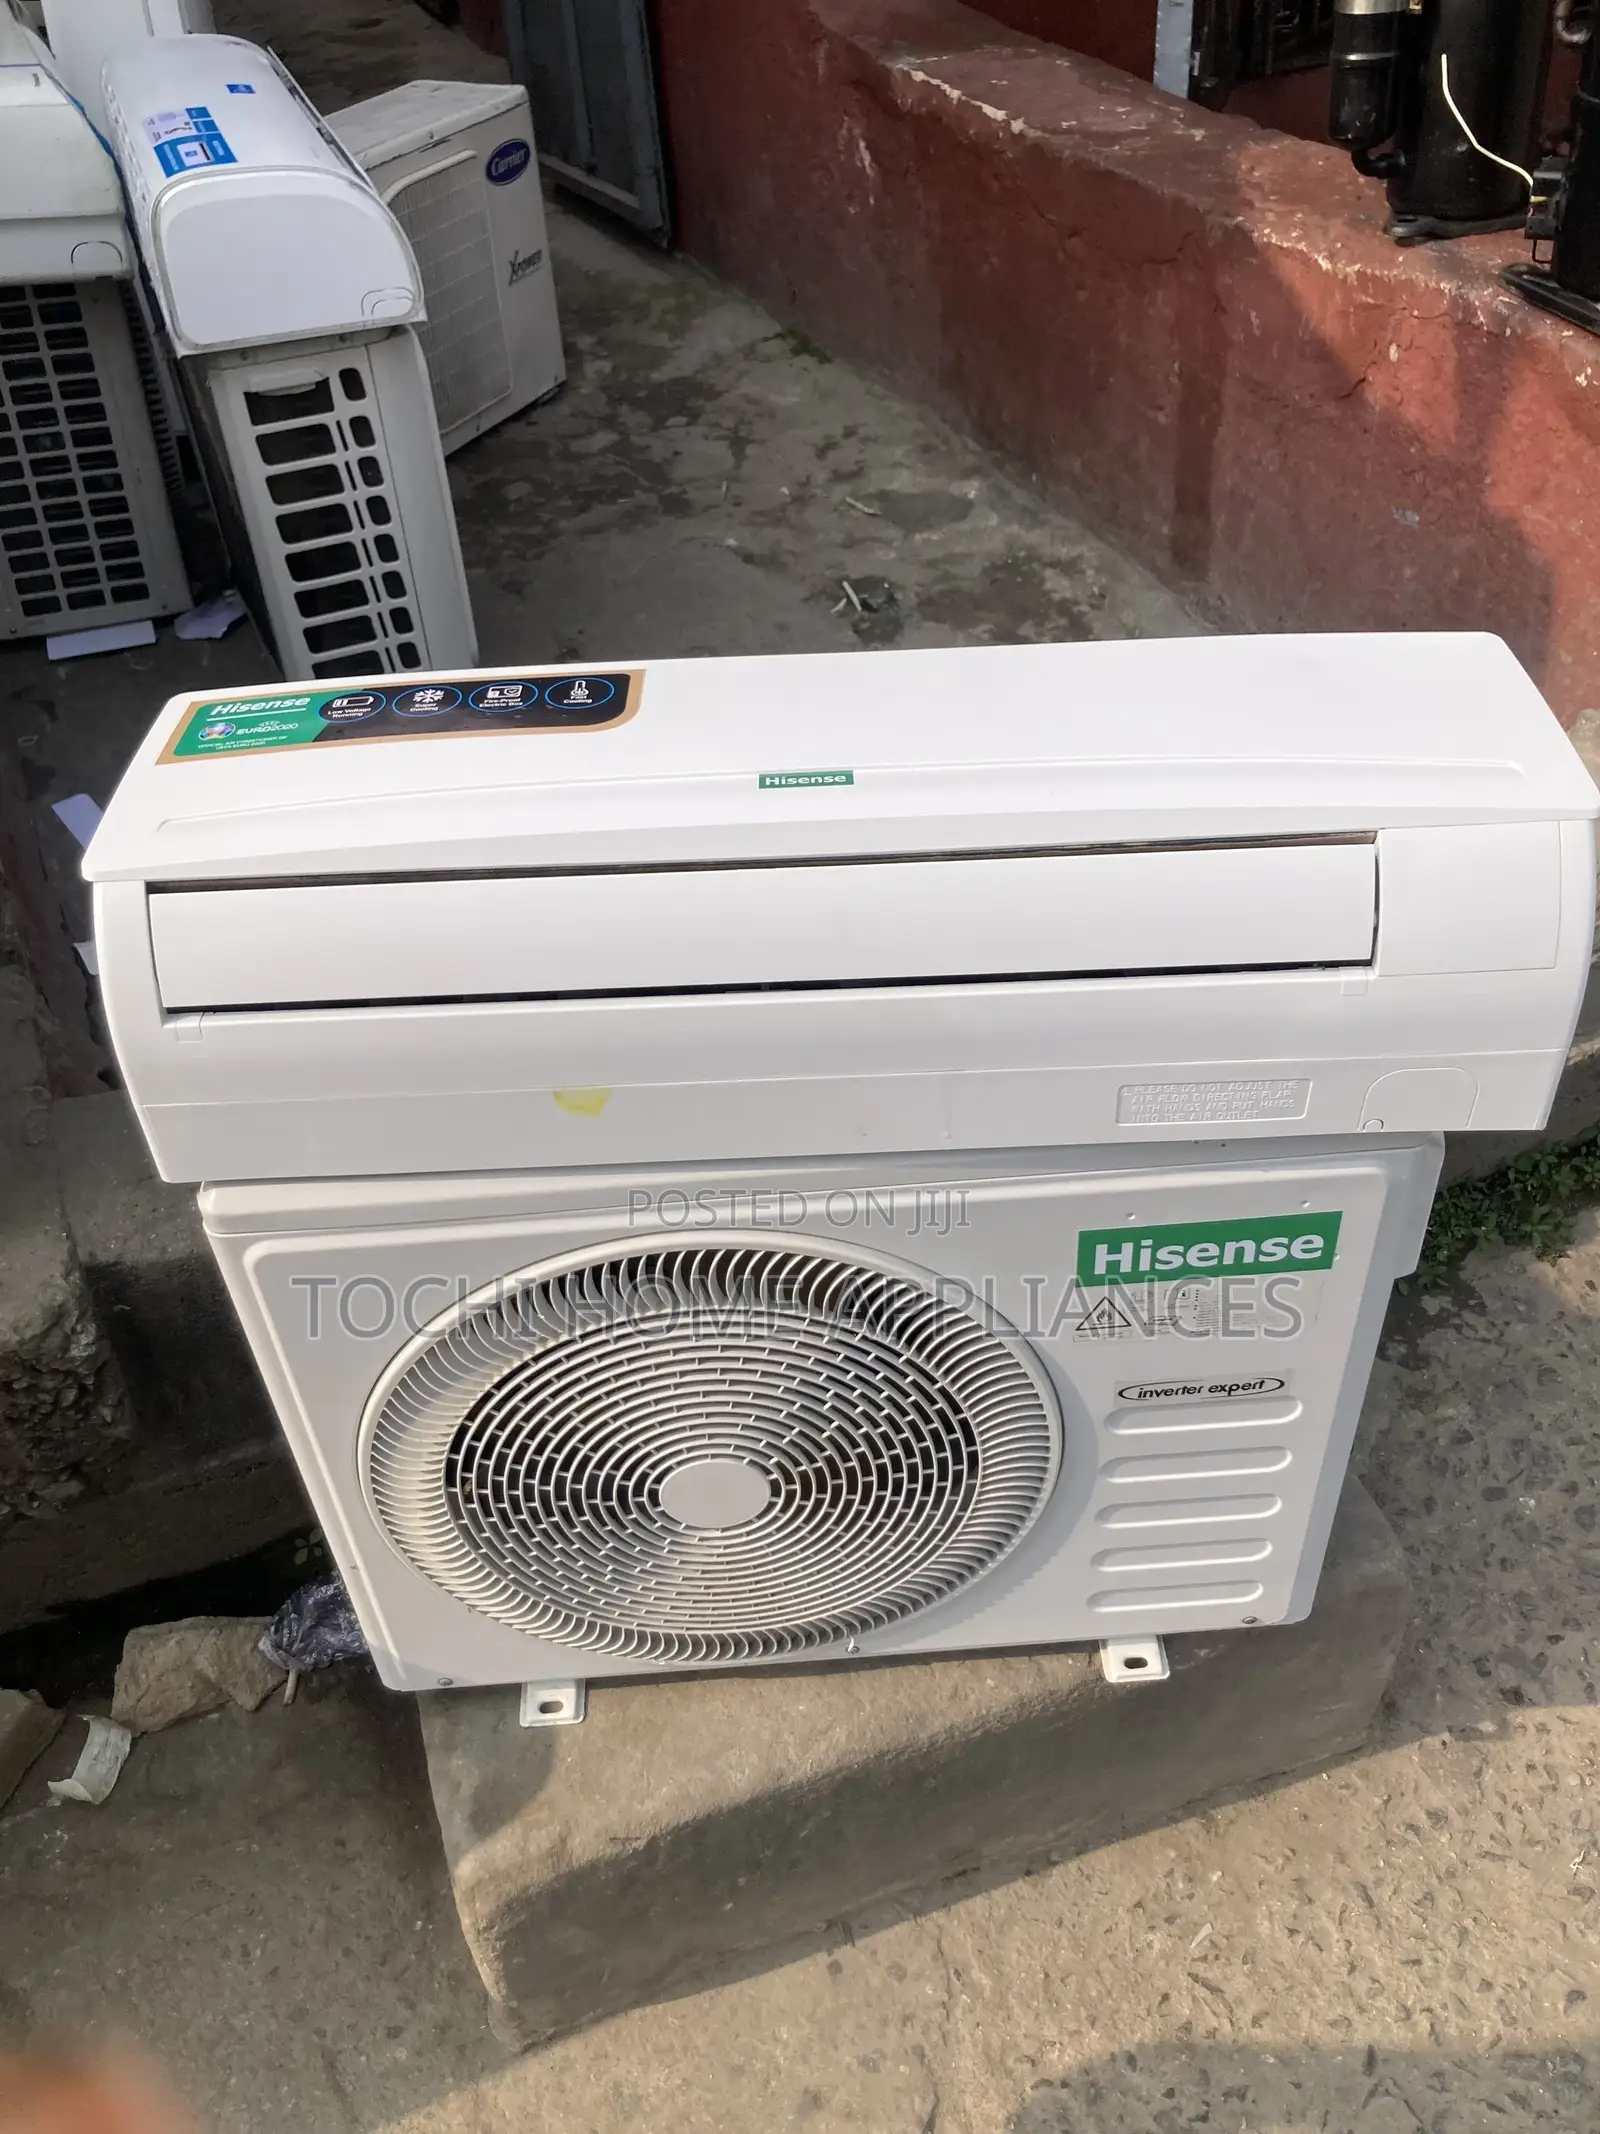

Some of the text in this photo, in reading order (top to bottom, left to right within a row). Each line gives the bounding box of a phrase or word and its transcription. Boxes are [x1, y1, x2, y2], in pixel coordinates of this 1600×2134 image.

[491, 148, 528, 177] Carrier
[210, 697, 311, 716] Hisense
[765, 775, 847, 786] Hisense
[1134, 1080, 1299, 1095] PLEASE DO NOT ADJUST THE
[1131, 1090, 1293, 1104] AIR FLOW DIRECTING FLAP
[1131, 1099, 1296, 1113] WITH HANDS AND PUT HANDS
[1132, 1110, 1260, 1122] INTO THE AIR OUTLET
[1093, 1233, 1324, 1275] Hisense
[1137, 1380, 1265, 1399] inverter expert
